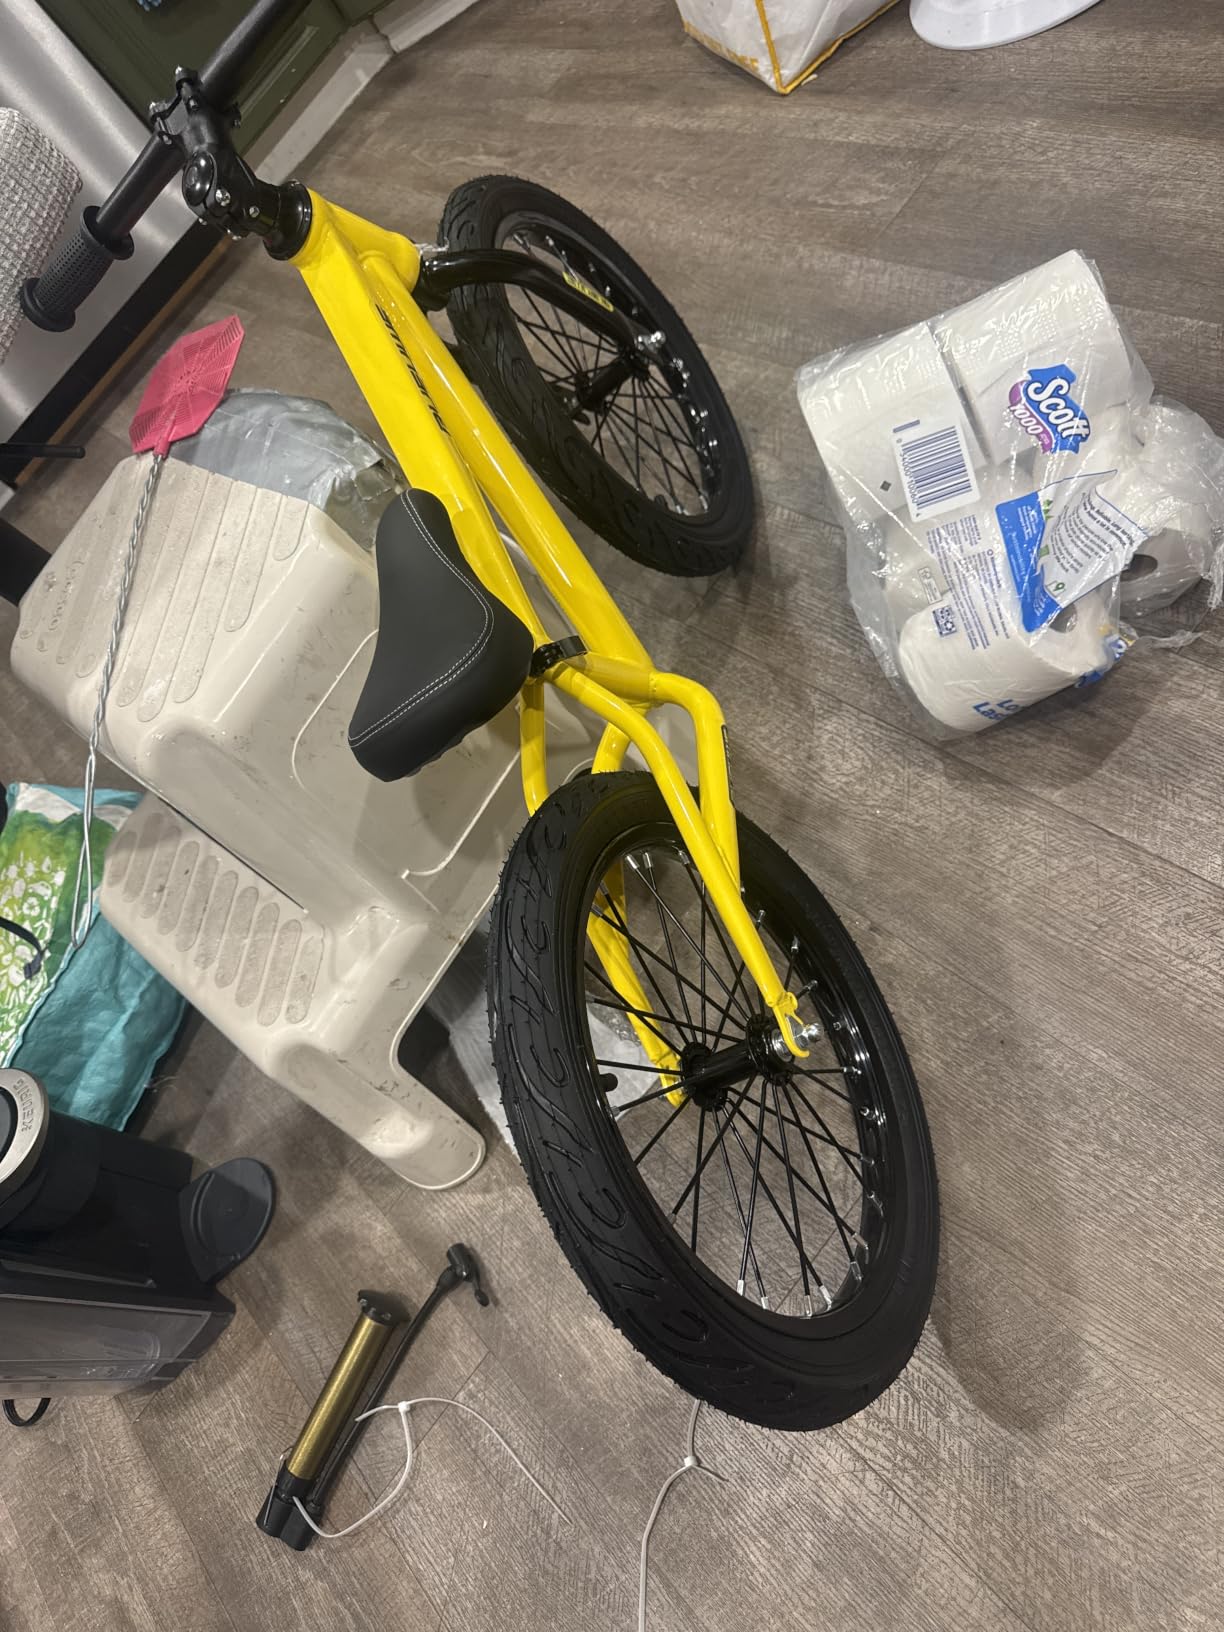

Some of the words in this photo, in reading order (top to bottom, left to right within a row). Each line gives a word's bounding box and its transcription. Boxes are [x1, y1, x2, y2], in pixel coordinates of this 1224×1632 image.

[1009, 404, 1044, 435] 1000
[1026, 377, 1090, 440] Scott
[13, 1079, 34, 1132] KEURIG
